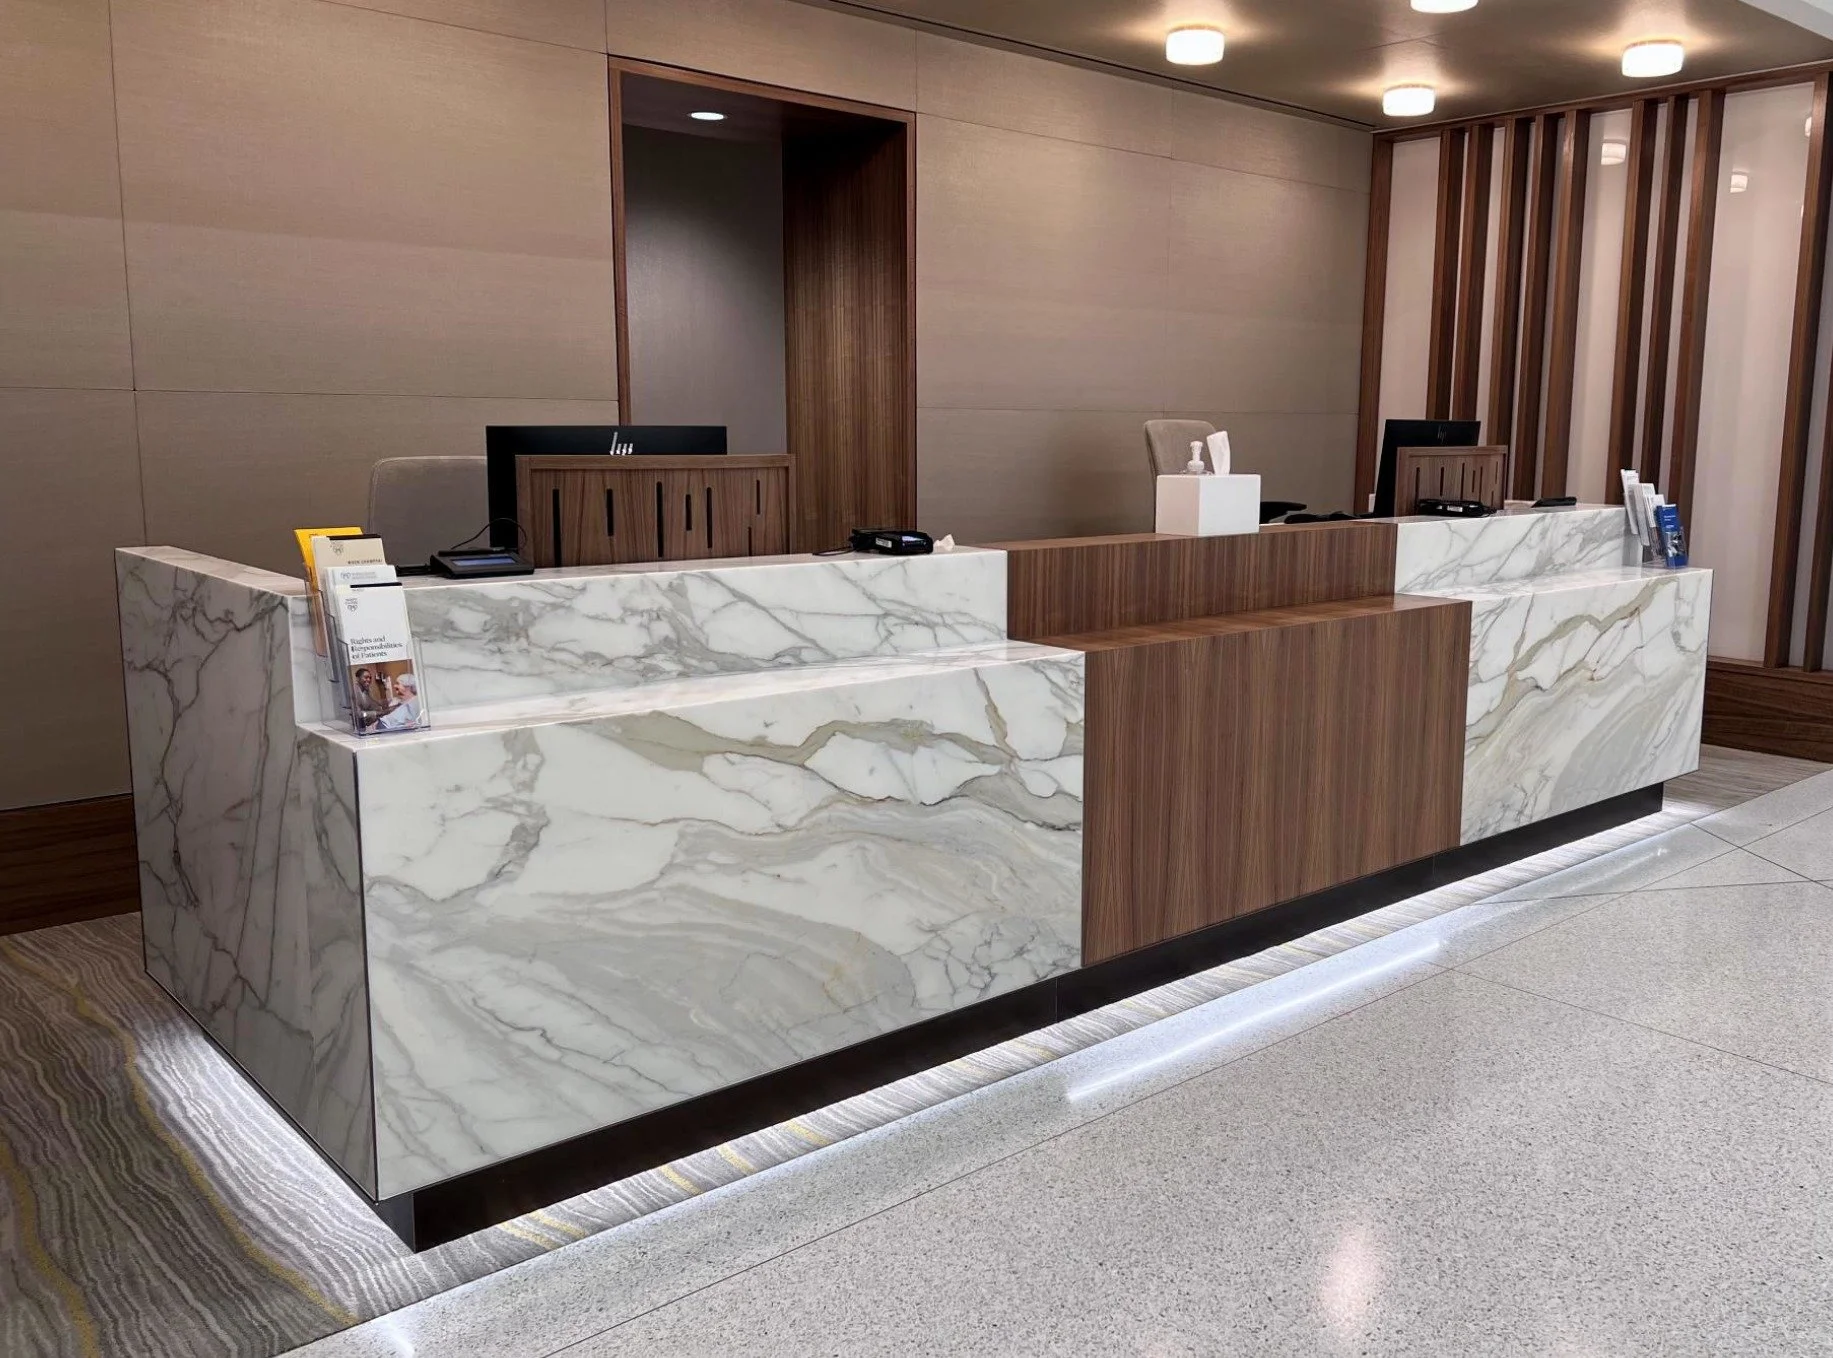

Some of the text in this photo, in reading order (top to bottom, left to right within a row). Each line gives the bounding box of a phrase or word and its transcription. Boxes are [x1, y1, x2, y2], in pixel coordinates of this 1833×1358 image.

[351, 636, 373, 645] Rights
[351, 643, 403, 652] Responsibilities
[361, 651, 387, 659] Patients
